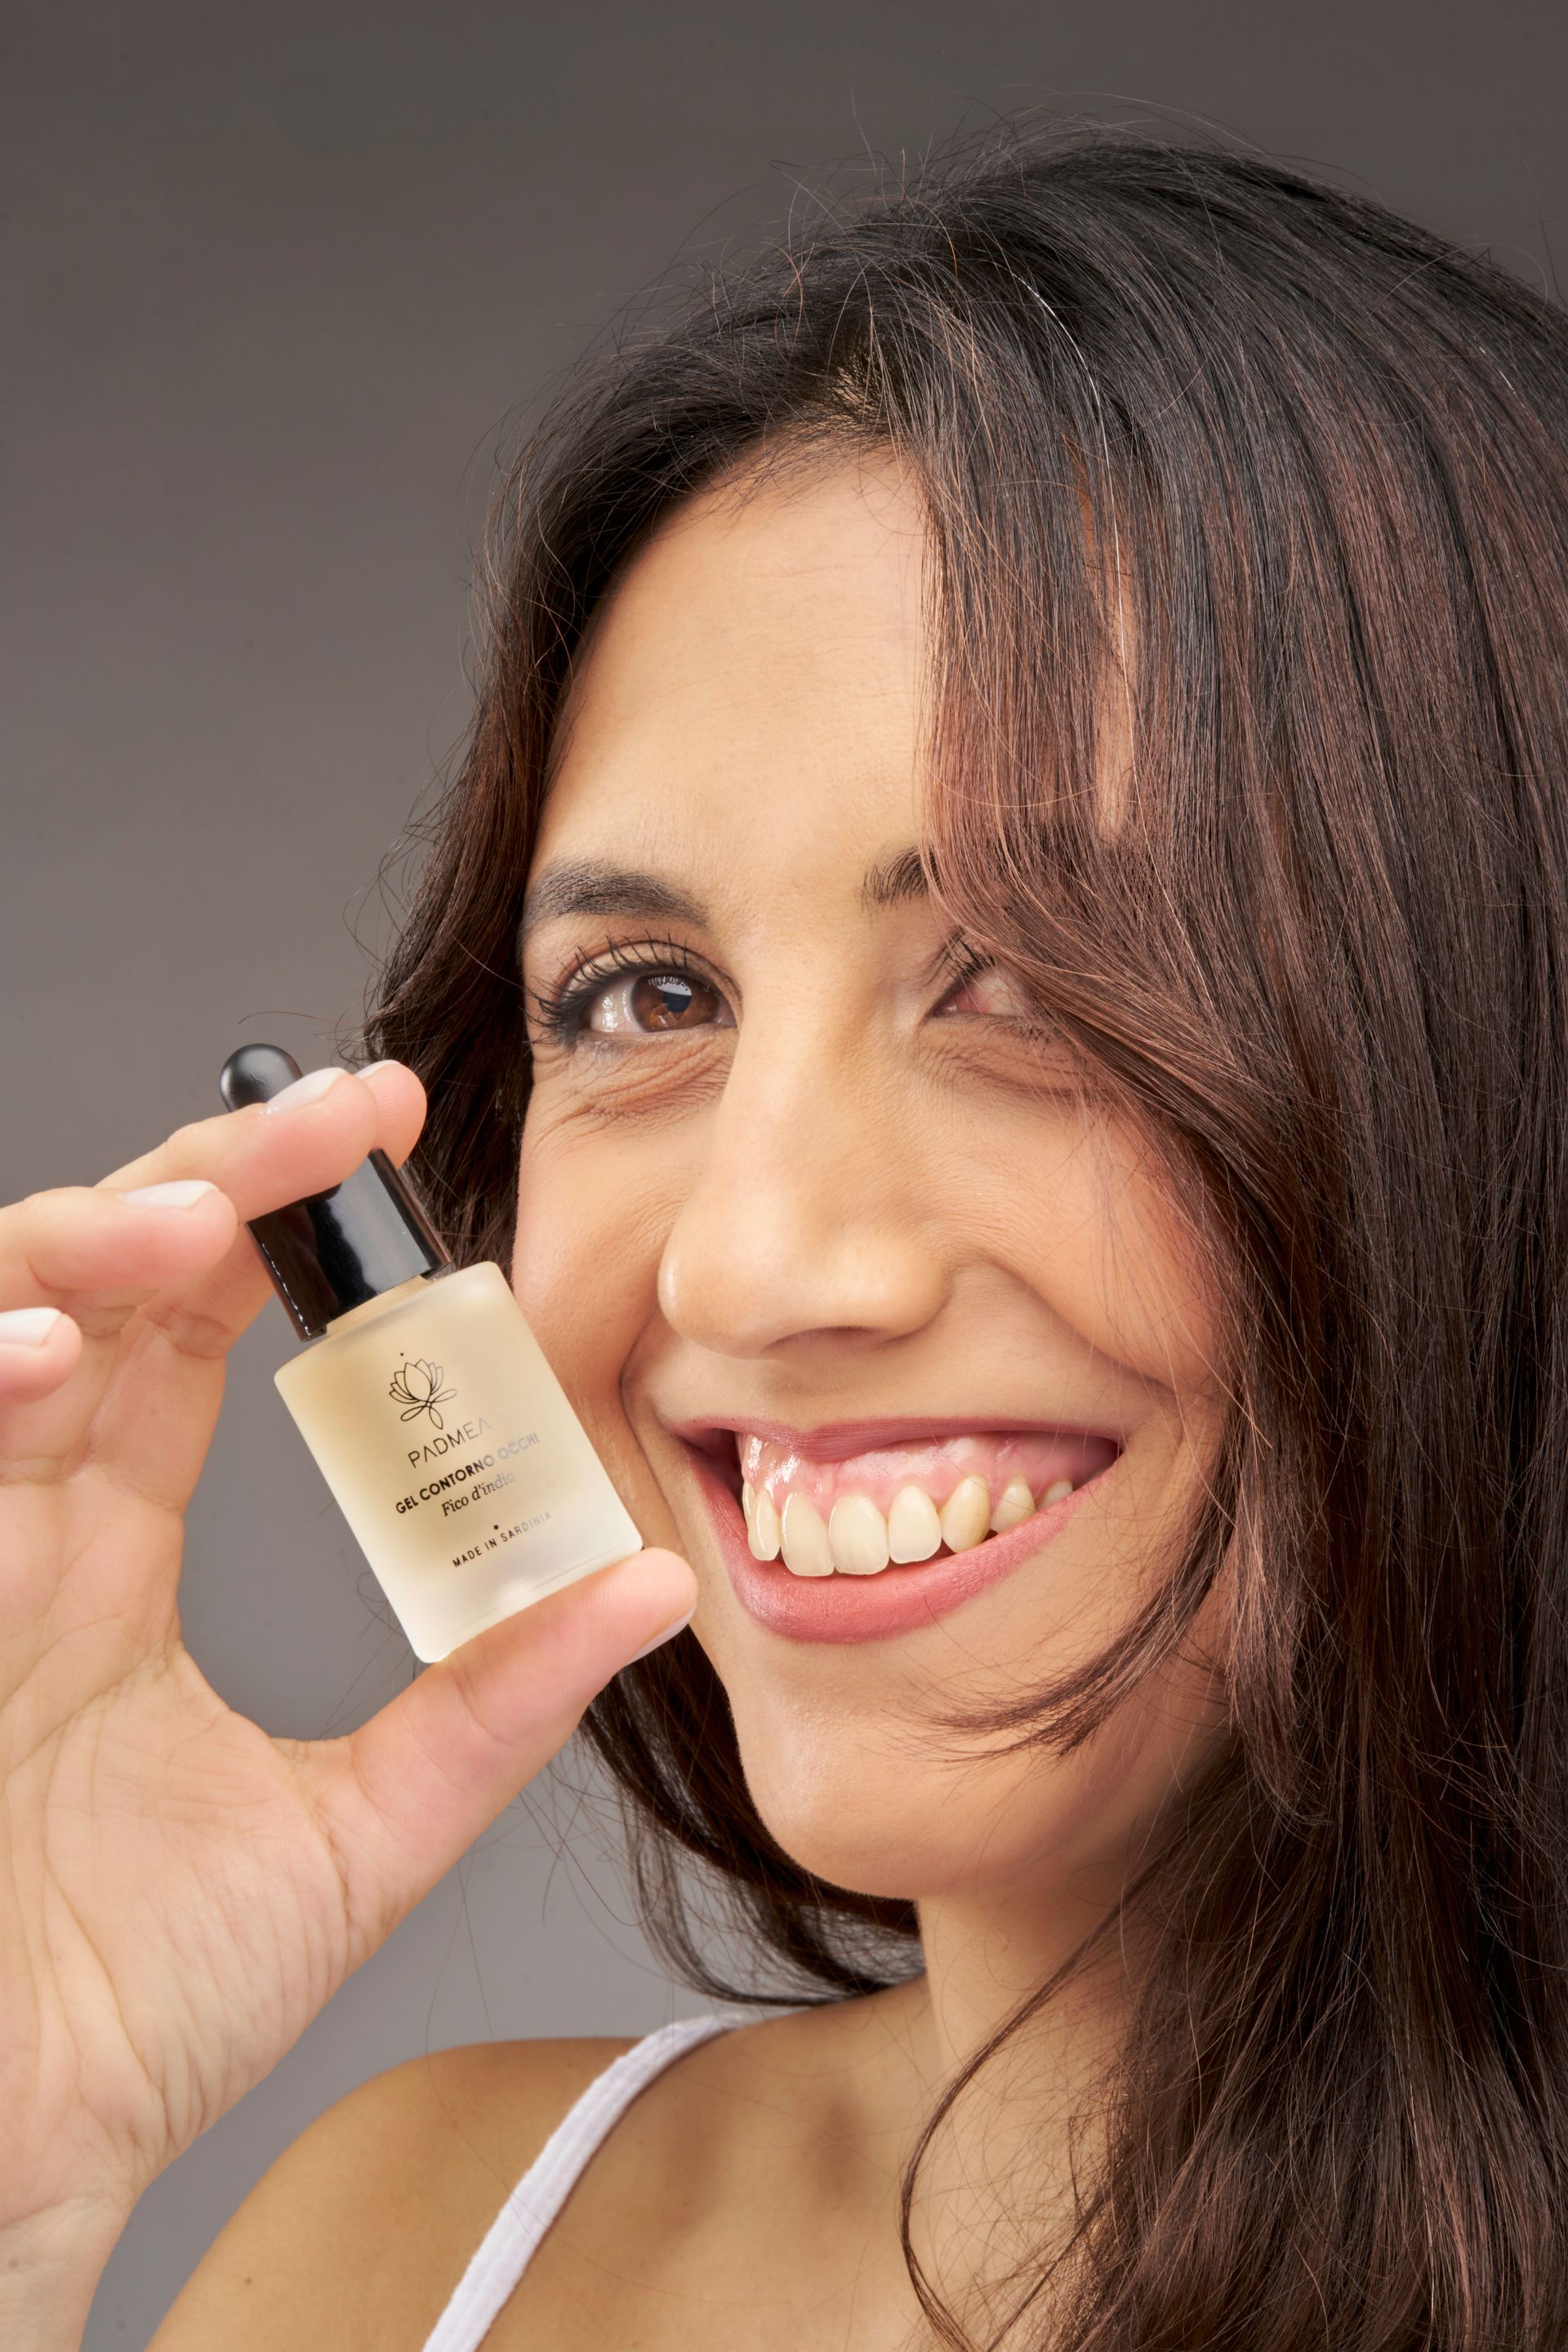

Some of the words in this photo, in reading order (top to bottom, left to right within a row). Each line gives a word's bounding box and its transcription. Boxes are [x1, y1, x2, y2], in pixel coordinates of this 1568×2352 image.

[395, 1494, 419, 1514] GEL
[420, 1454, 495, 1500] CONTORNO
[497, 1432, 540, 1460] OCCHI
[441, 1495, 469, 1517] Fico
[452, 1546, 482, 1568] MADE
[484, 1538, 497, 1551] IN
[501, 1511, 552, 1543] SARDINIA
